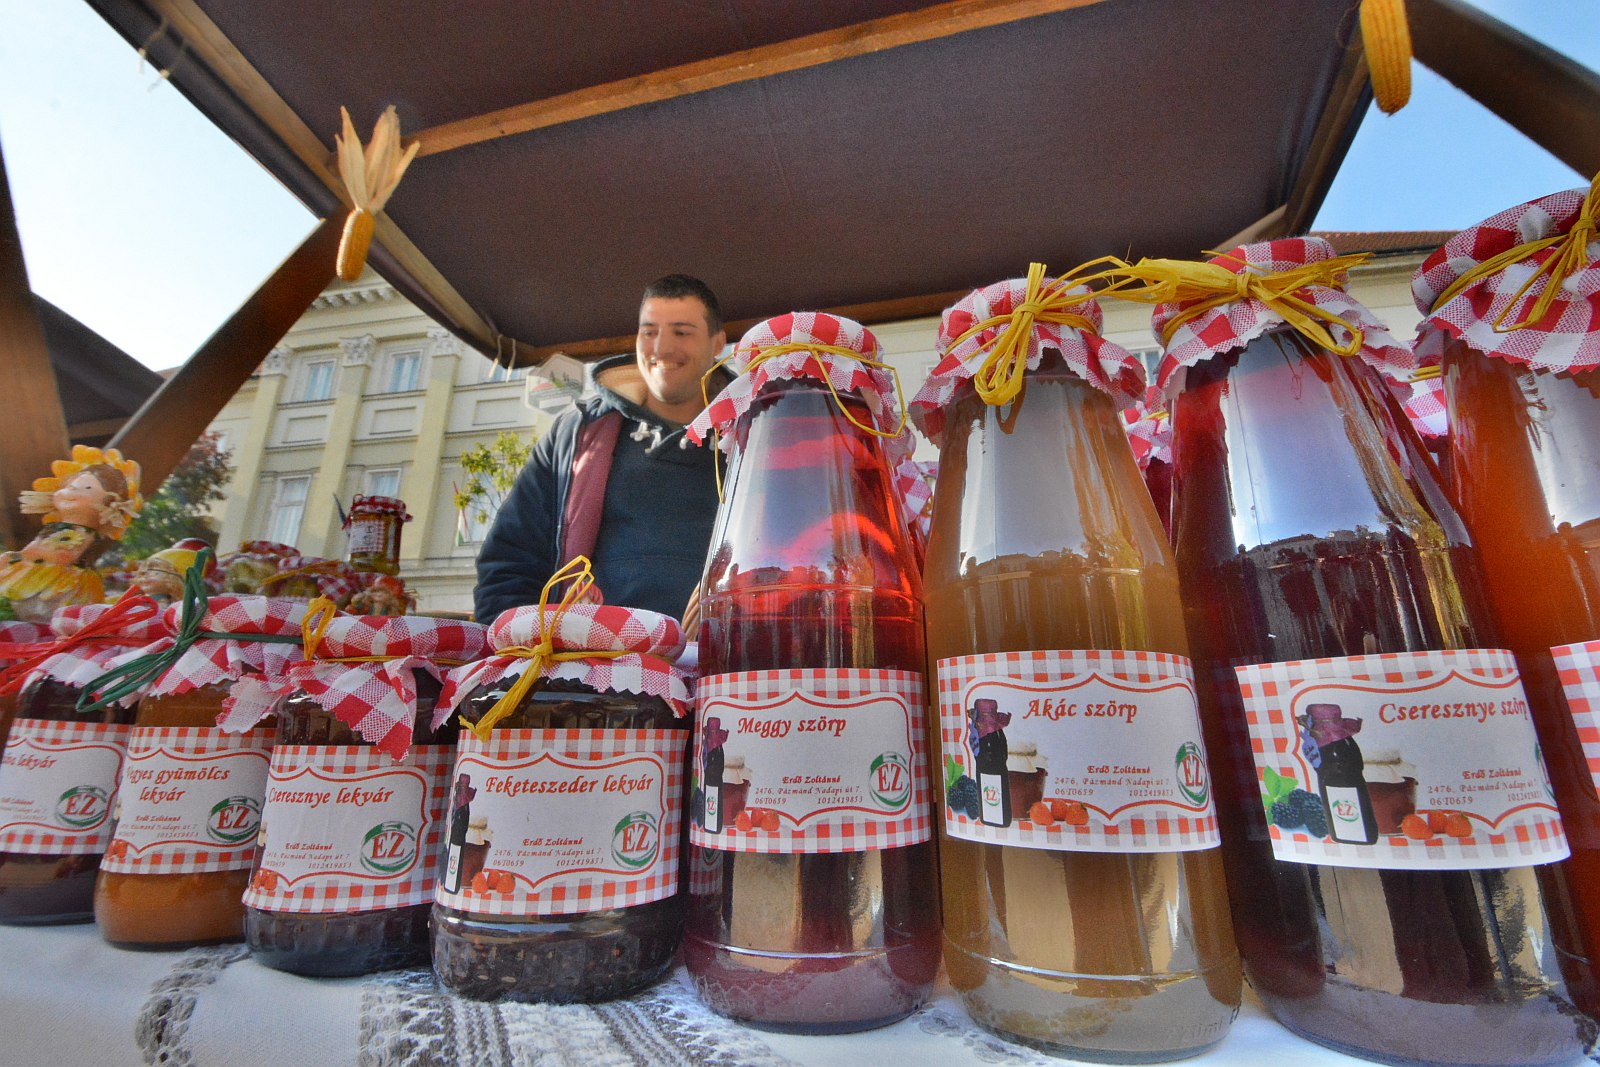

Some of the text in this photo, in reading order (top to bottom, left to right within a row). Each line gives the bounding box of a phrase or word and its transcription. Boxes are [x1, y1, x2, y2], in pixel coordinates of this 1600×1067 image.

[1022, 698, 1138, 723] Akác szörp
[1379, 699, 1496, 724] Cseresznye
[738, 716, 846, 738] Meggy szörp
[155, 765, 230, 784] gyümölcs
[782, 775, 841, 785] Erdő Zoltánné
[877, 763, 903, 792] EZ
[1087, 764, 1110, 774] Erdő
[1184, 753, 1203, 788] EZ
[140, 786, 186, 804] lekvár
[268, 786, 394, 809] Cseresznye lekvár
[486, 774, 654, 798] Feketeszeder lekvár
[64, 793, 98, 815] EZ
[217, 806, 250, 830] EZ
[370, 832, 406, 860] EZ
[523, 836, 584, 847] Erdő Zoltánné
[621, 823, 650, 853] EZ
